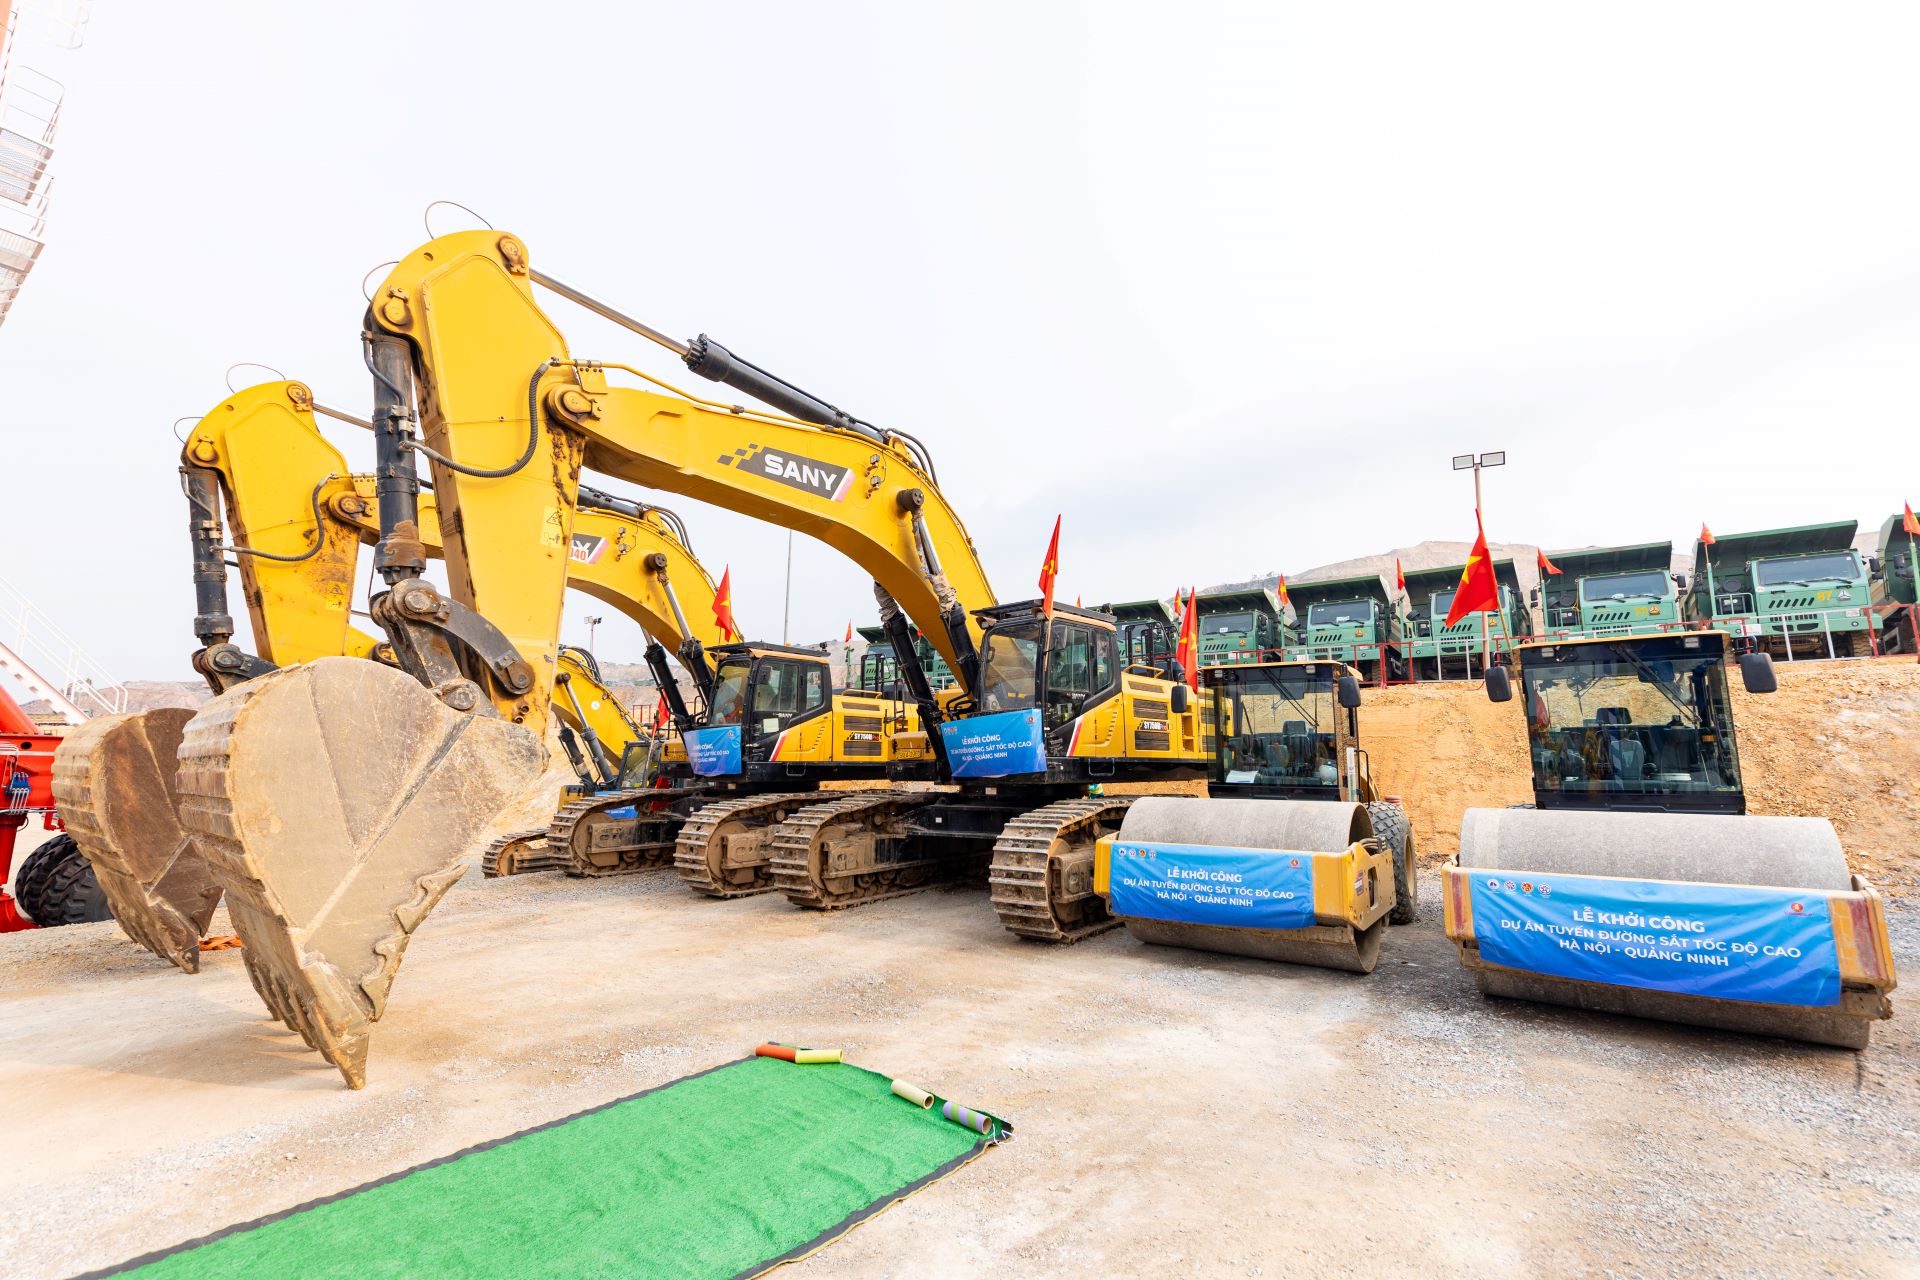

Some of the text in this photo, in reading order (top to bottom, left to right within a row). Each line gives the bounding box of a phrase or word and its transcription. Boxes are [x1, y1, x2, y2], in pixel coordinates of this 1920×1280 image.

[764, 454, 837, 490] SANY
[981, 734, 1001, 743] CÔNG
[1168, 866, 1242, 882] LỄ KHỞI CÔNG
[1124, 878, 1294, 899] DỰ ÁN TUYẾN ĐƯỜNG SẮT TỐC ĐỘ CAO
[1157, 890, 1169, 899] HÀ
[1172, 892, 1187, 902] NỘI
[1194, 894, 1227, 904] QUẢNG
[1229, 898, 1253, 907] NINH
[1573, 906, 1705, 932] LỄ KHỞI CÔNG
[1501, 919, 1801, 958] DỰ ÁN TUYẾN ĐƯỜNG SẮT TỐC ĐỘ CAO
[1559, 939, 1580, 950] HÀ
[1584, 941, 1611, 955] NỘI
[1624, 947, 1682, 962] QUẢNG
[1687, 953, 1729, 967] NINH
